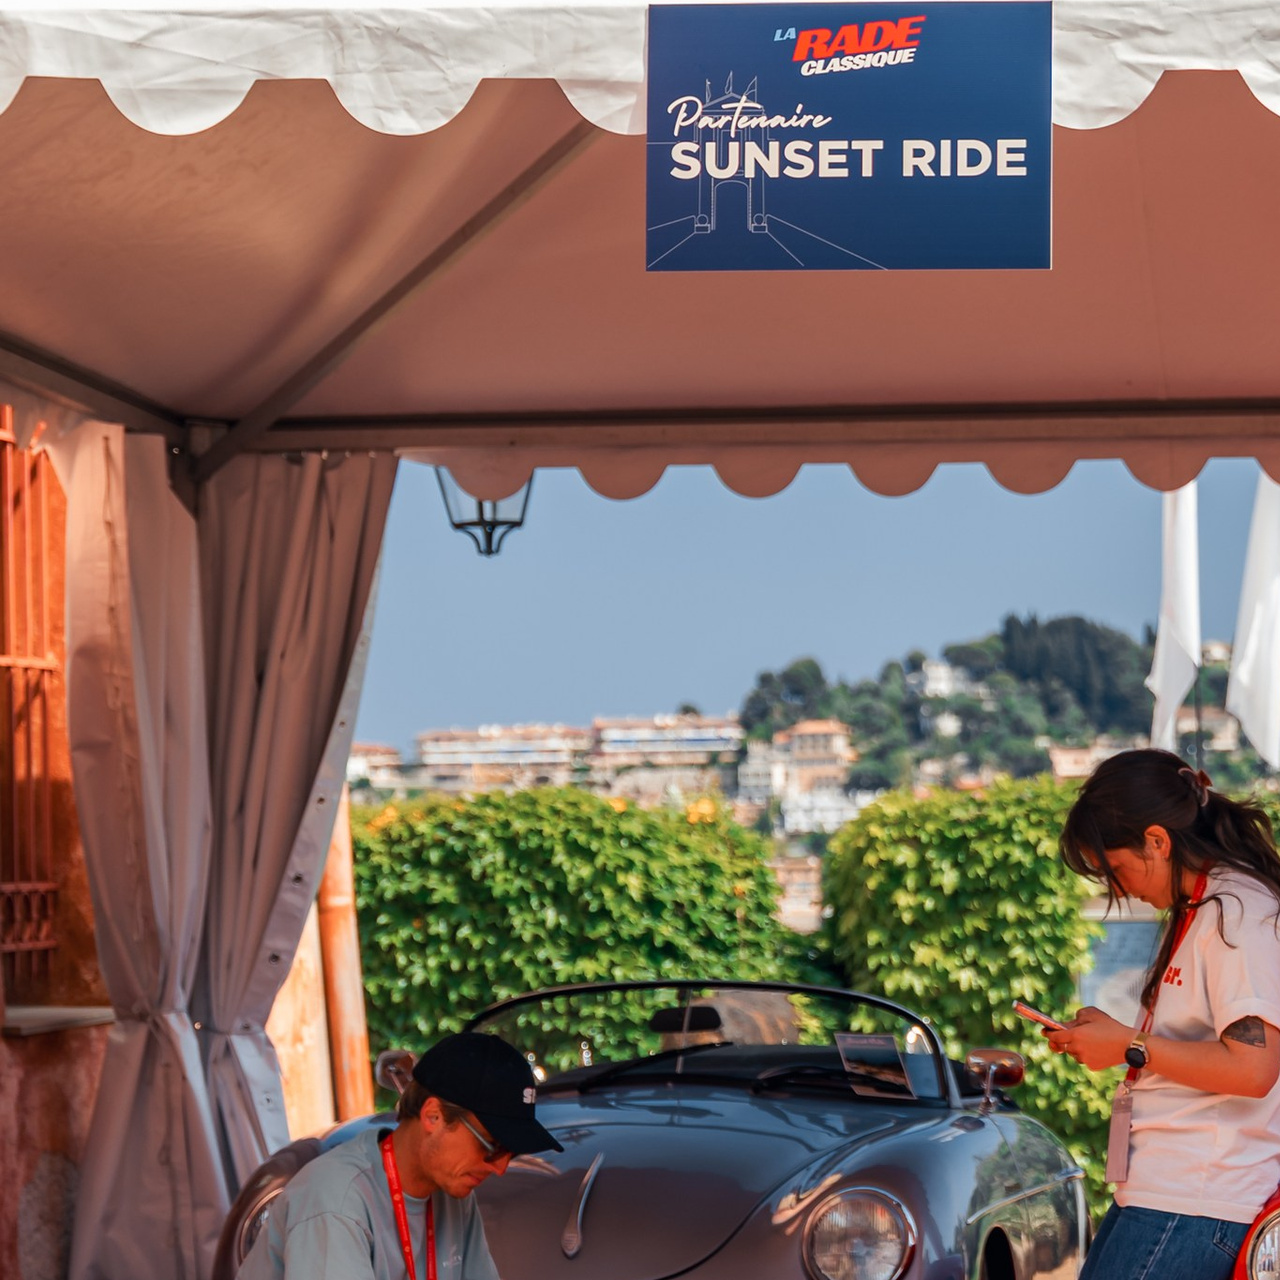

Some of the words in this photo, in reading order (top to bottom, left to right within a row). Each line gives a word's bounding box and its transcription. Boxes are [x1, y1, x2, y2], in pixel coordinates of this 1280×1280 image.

[773, 27, 797, 42] LA
[792, 15, 927, 62] RADE
[801, 48, 917, 77] CLASSIQUE
[667, 95, 832, 138] Partenaire
[670, 140, 884, 180] SUNSET
[902, 139, 1028, 178] RIDE
